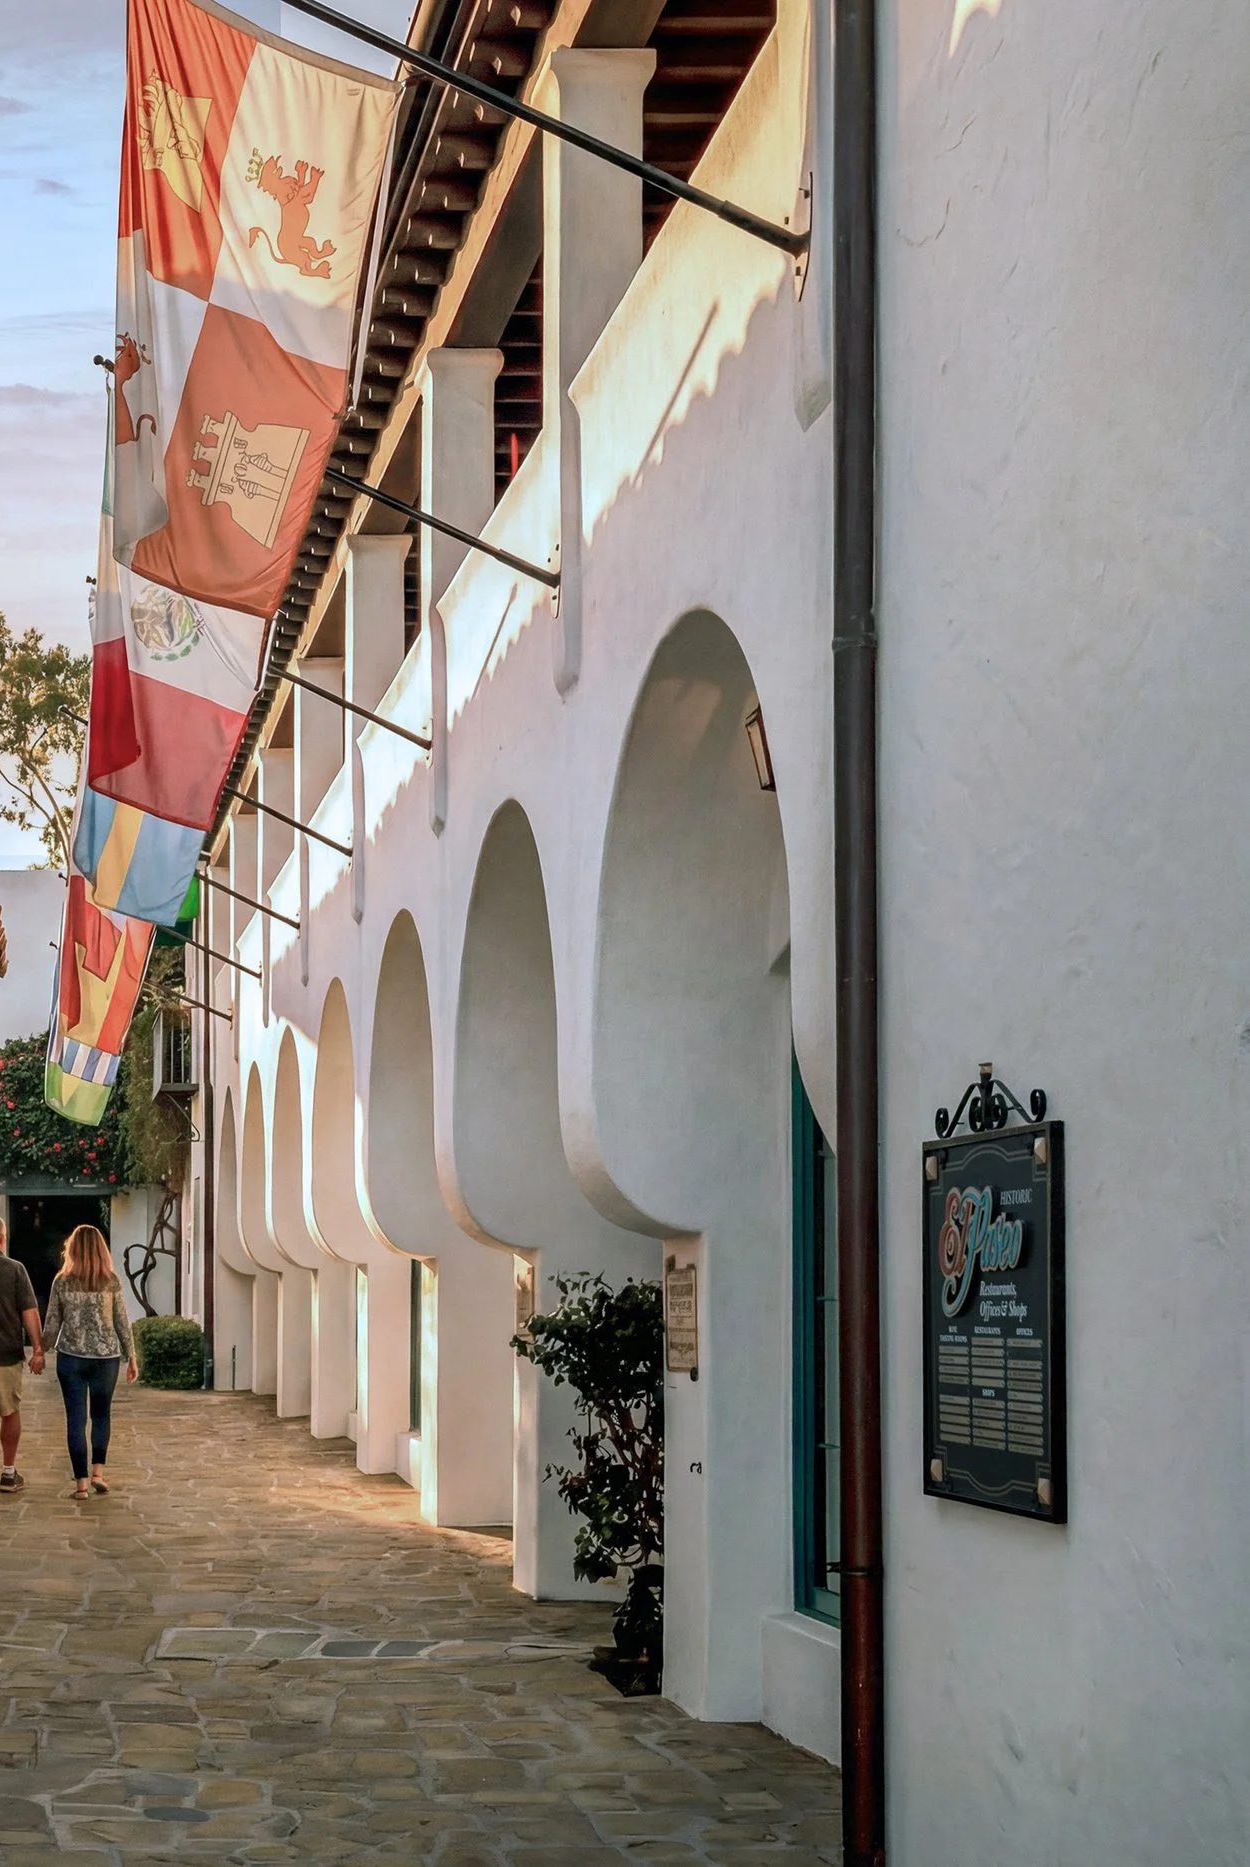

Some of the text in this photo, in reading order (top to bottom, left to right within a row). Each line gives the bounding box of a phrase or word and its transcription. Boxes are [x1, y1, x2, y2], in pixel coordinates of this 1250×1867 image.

[1000, 1188, 1032, 1206] HISTORIC
[979, 1280, 1017, 1299] Restaurants,
[1008, 1300, 1028, 1323] Shops
[974, 1326, 1001, 1335] RESTAURANTS
[1016, 1328, 1033, 1336] OFFICES
[982, 1389, 995, 1397] SHOPS
